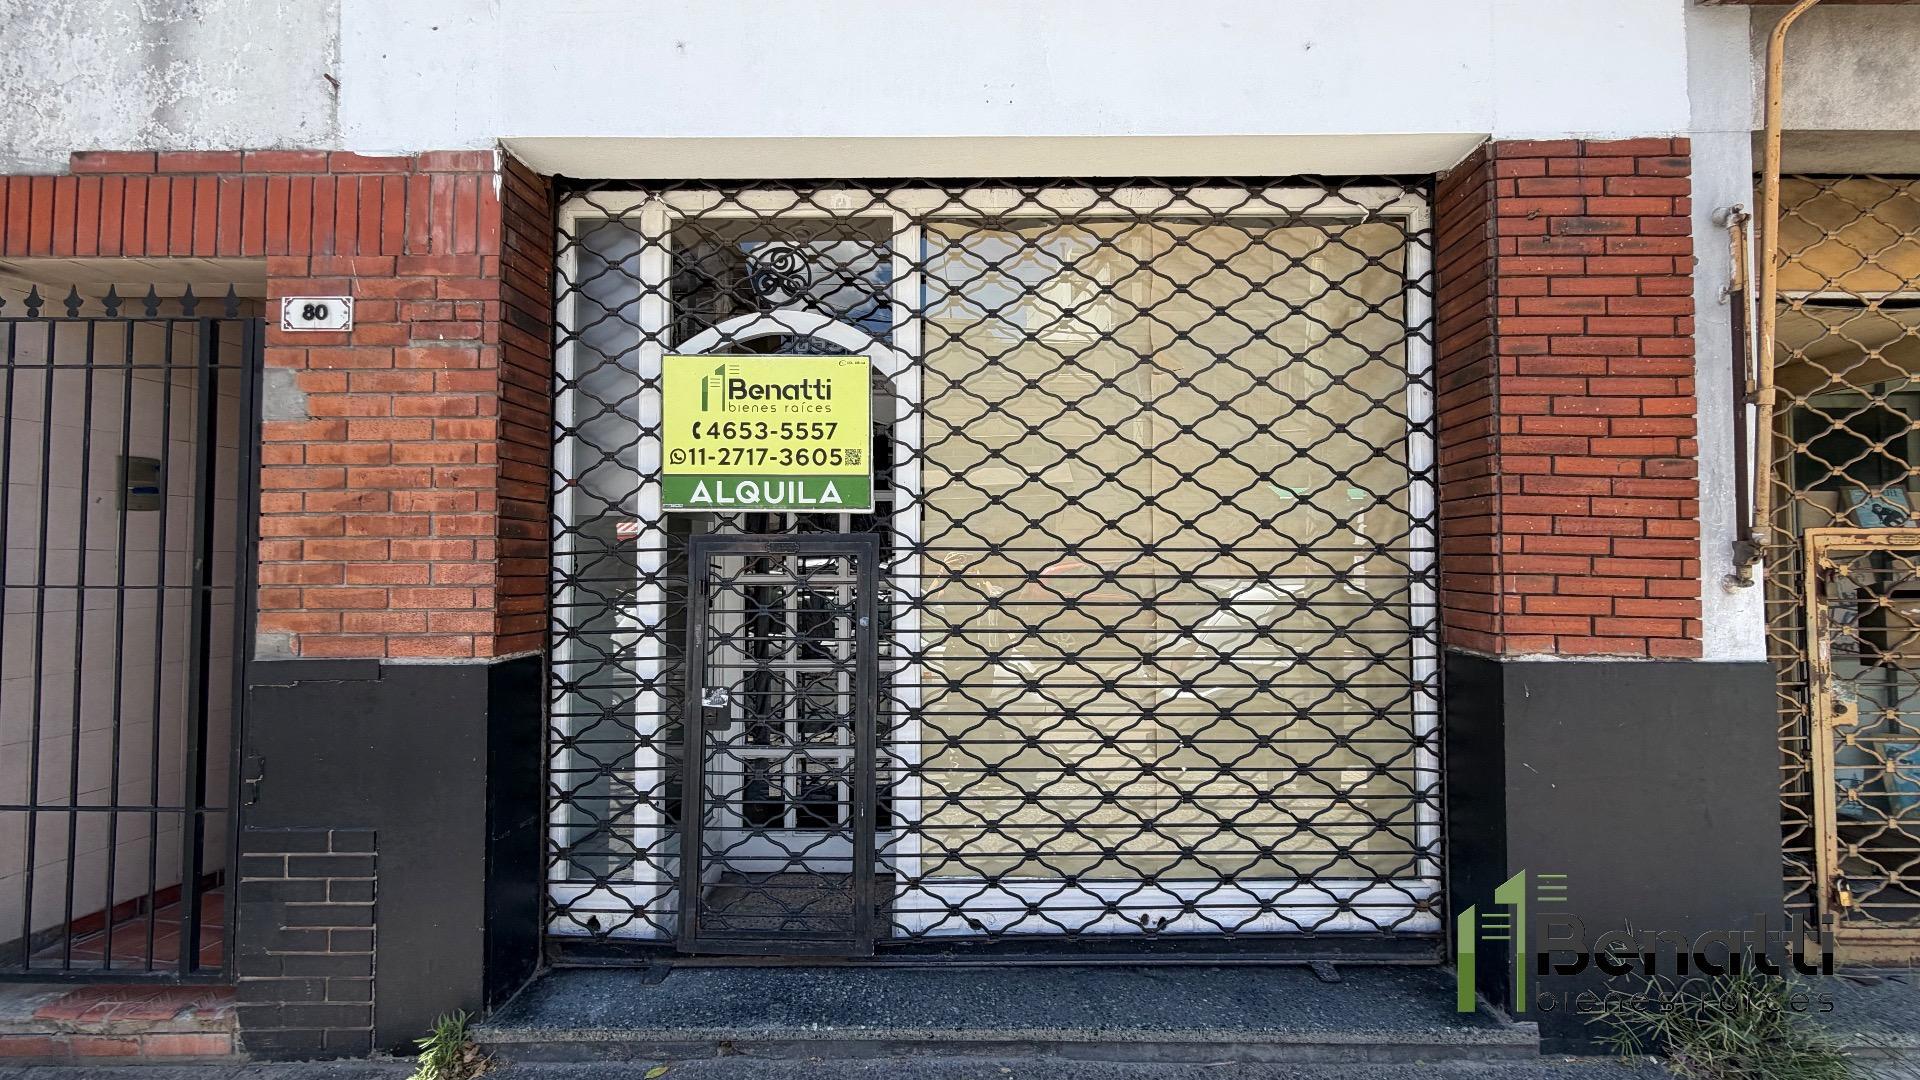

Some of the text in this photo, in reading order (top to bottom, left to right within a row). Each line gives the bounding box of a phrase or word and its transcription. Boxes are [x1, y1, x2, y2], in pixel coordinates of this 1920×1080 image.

[302, 304, 328, 321] 80
[728, 378, 831, 400] Benatti
[728, 401, 832, 413] bienes raíces
[707, 422, 838, 440] 4653-5557
[688, 448, 843, 466] 11-2717-3605
[690, 480, 842, 504] ALQUILA
